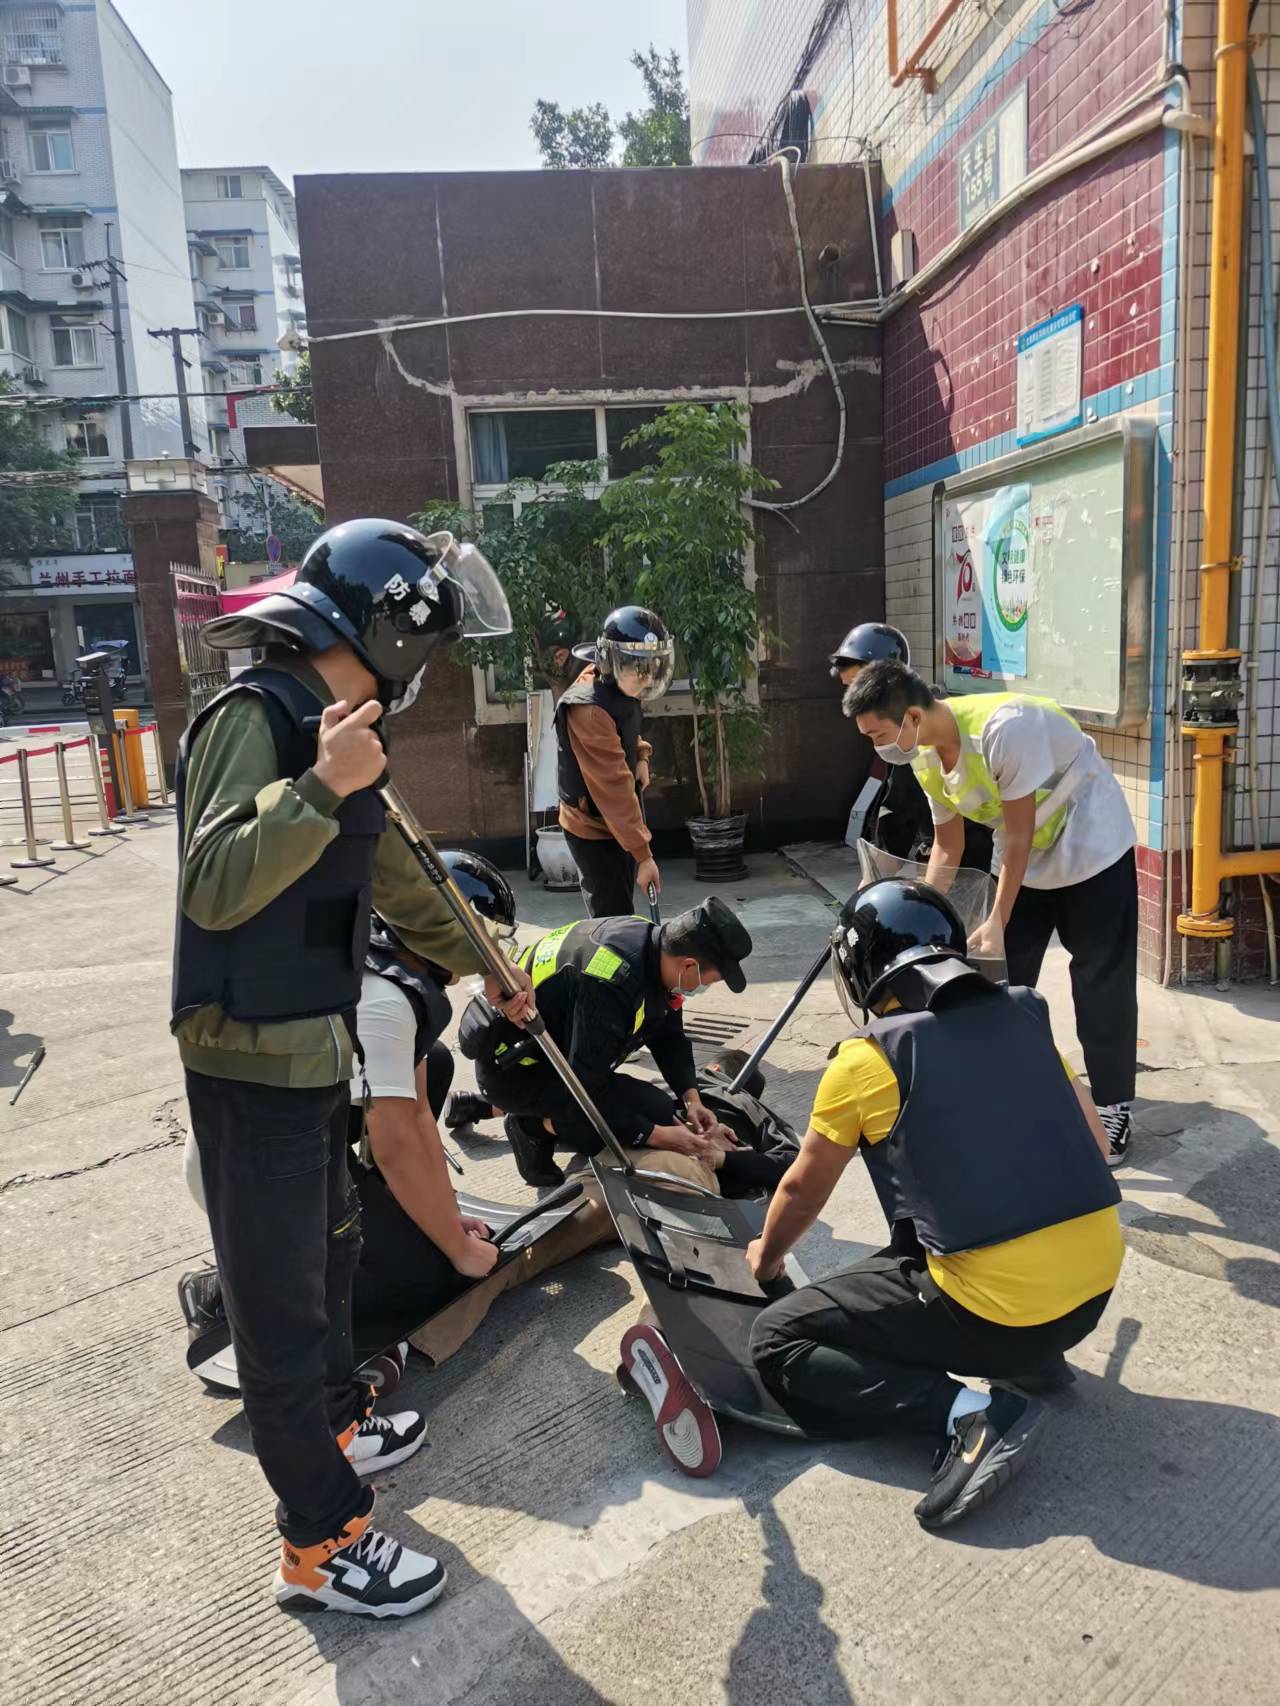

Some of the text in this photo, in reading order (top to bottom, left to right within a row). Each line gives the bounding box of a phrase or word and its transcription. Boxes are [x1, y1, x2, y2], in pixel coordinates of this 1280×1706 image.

[39, 568, 137, 588] 兰州手工拉面
